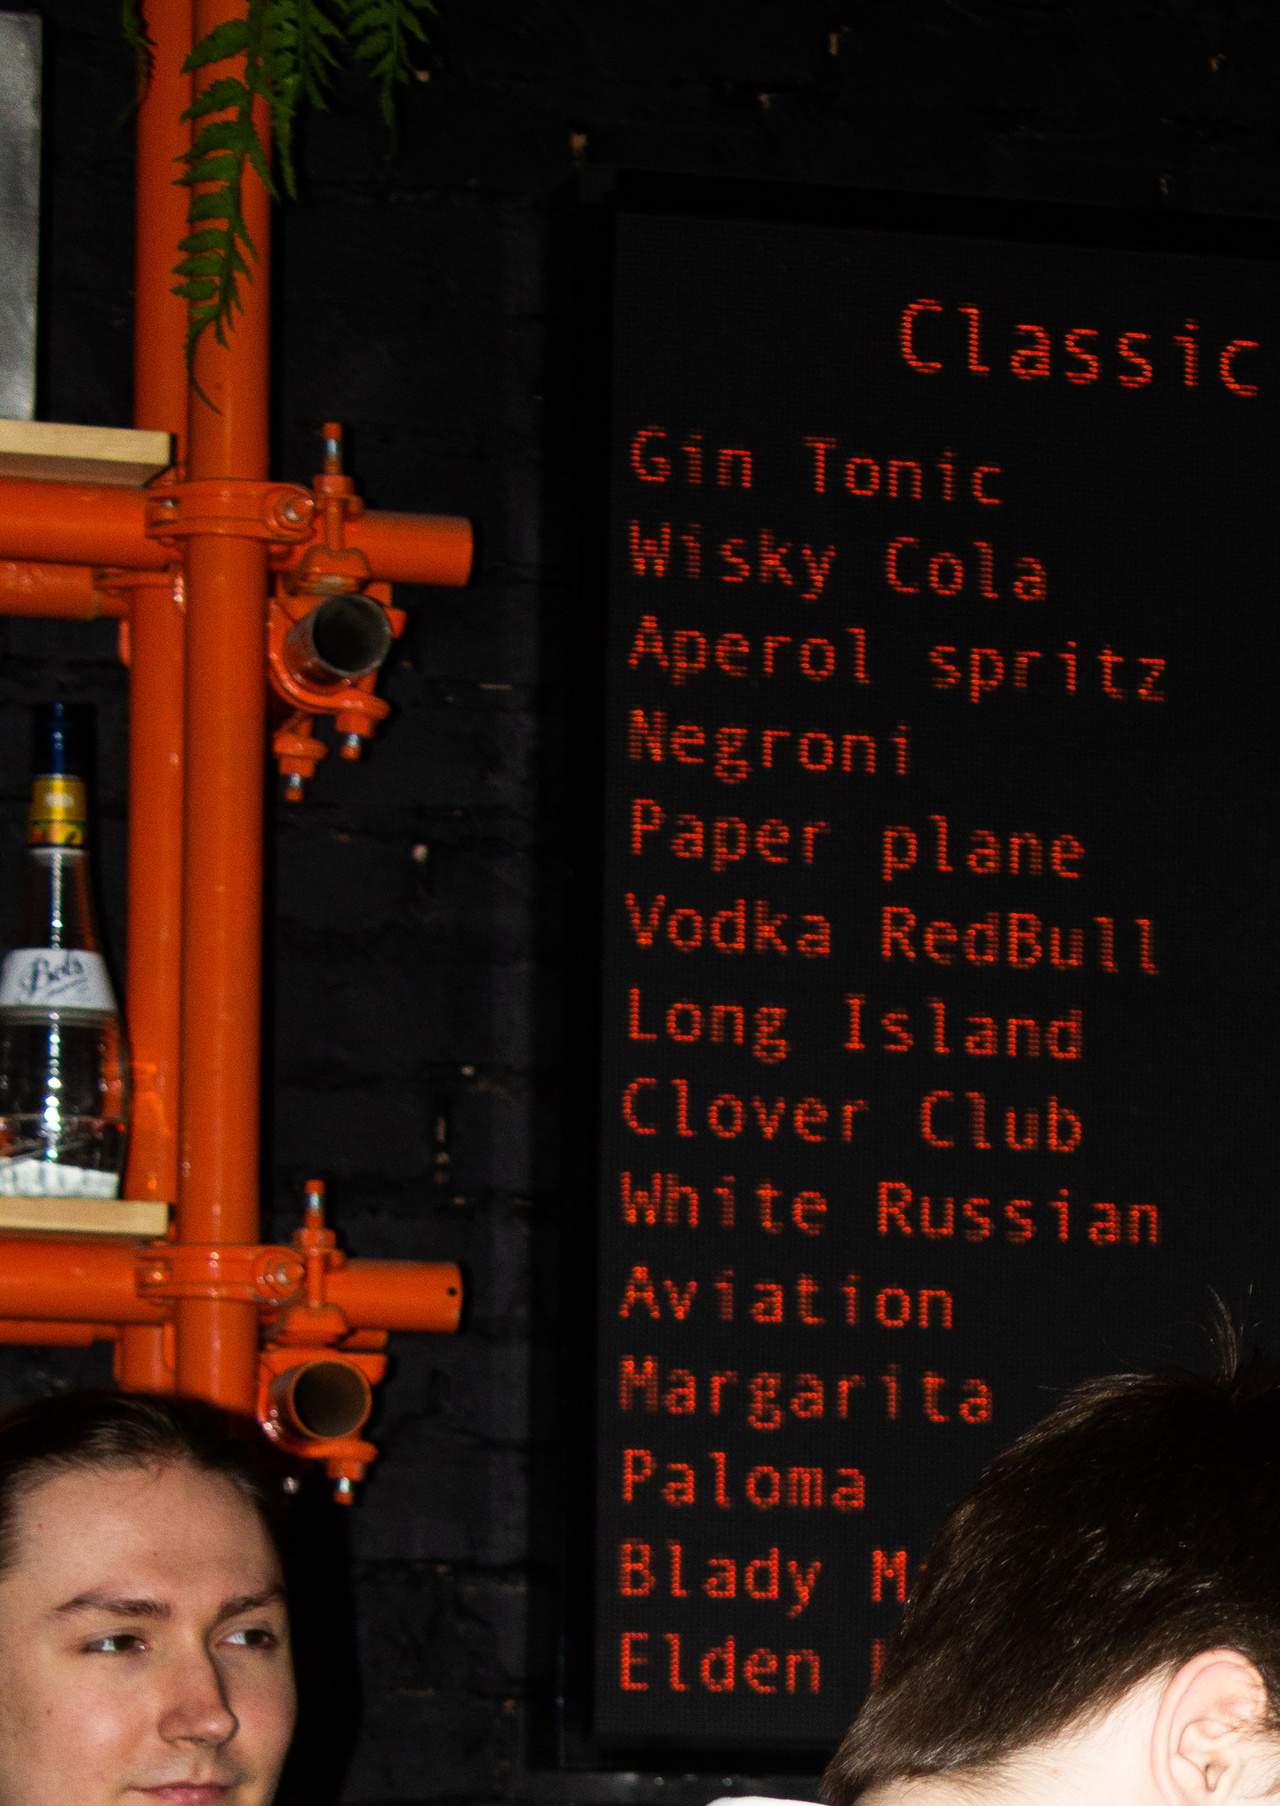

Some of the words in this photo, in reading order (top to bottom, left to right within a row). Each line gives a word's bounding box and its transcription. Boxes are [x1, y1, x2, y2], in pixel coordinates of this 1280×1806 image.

[900, 297, 1260, 397] Classic
[630, 426, 753, 489] Gin
[804, 436, 1004, 505] Tonic
[629, 519, 837, 599] Wisky
[886, 535, 1048, 601] Cola
[627, 614, 873, 684] Aperol
[928, 640, 1167, 705] spritz
[627, 708, 913, 785] Negroni
[629, 797, 830, 874] Paper
[882, 813, 1086, 882] plane
[624, 892, 832, 959] Vodka
[880, 905, 1160, 977] RedBull
[628, 987, 790, 1064] Long
[843, 992, 1085, 1062] Island
[620, 1076, 869, 1143] Clover
[918, 1089, 1083, 1155] Club
[619, 1170, 829, 1235] White
[877, 1180, 1161, 1248] Russian
[618, 1264, 954, 1331] Aviation
[618, 1354, 994, 1430] Margarita
[620, 1447, 866, 1511] Paloma
[618, 1540, 823, 1617] Blady
[871, 1547, 929, 1603] M
[618, 1632, 821, 1694] Elden
